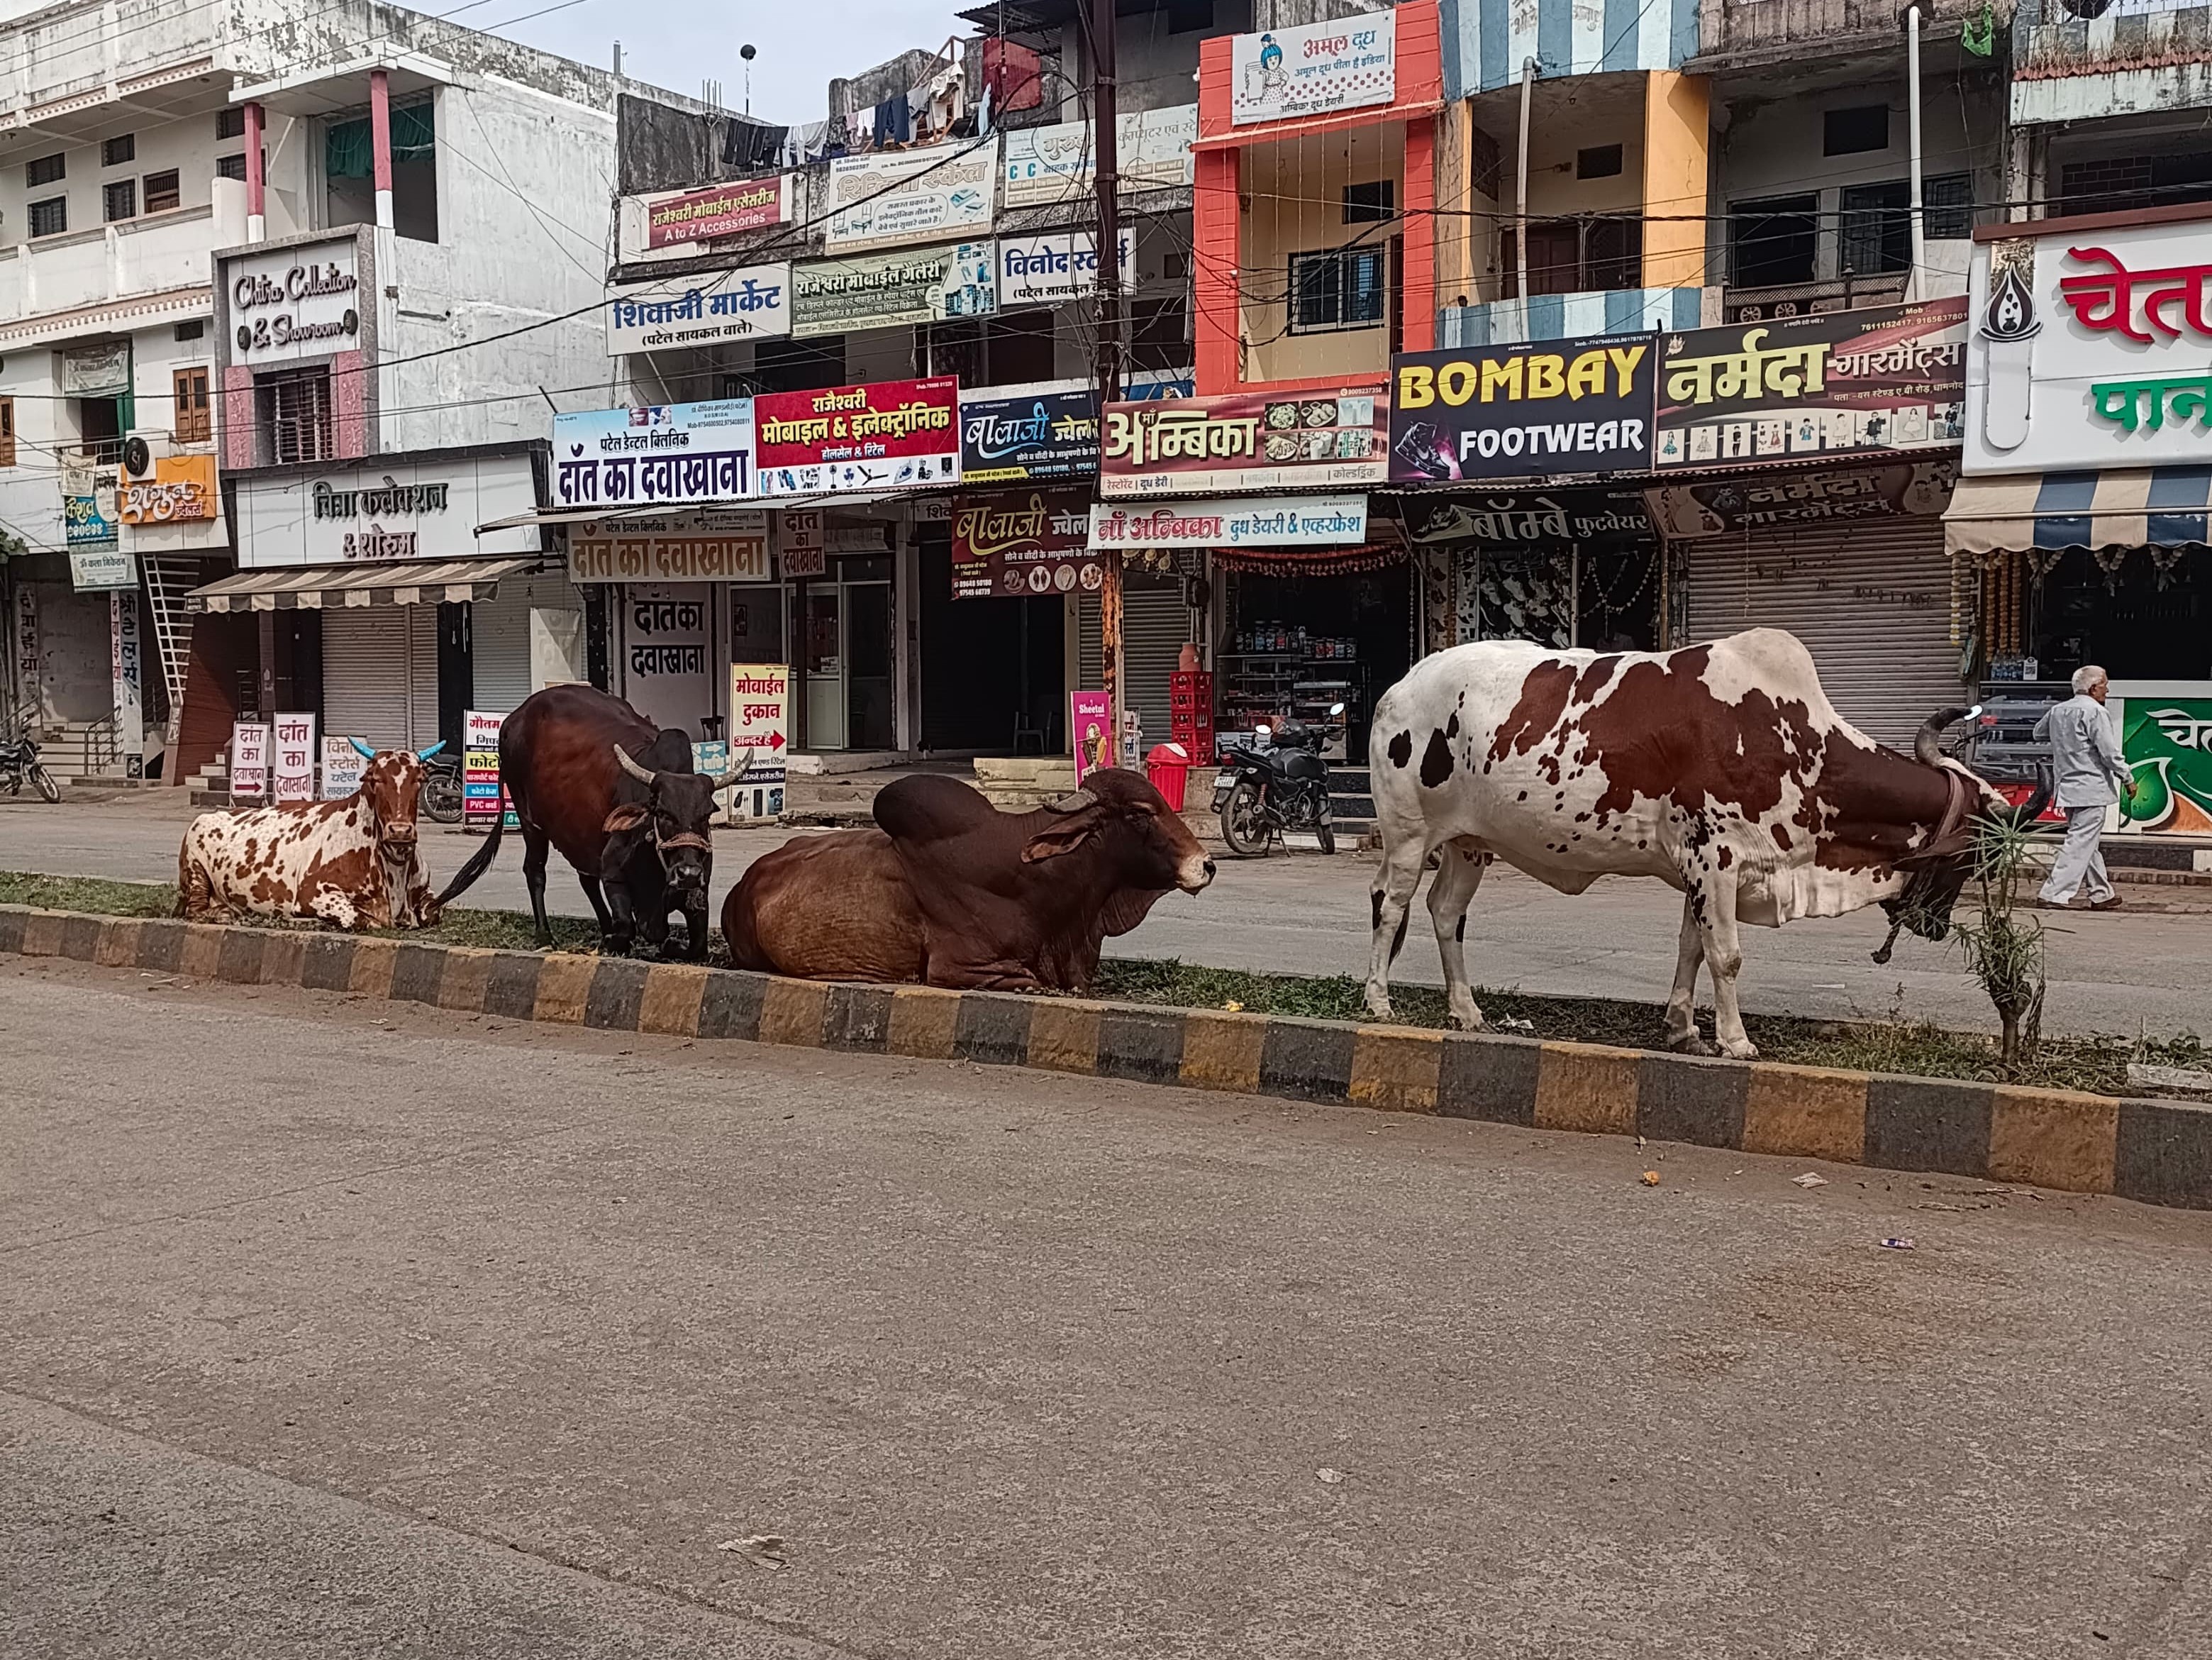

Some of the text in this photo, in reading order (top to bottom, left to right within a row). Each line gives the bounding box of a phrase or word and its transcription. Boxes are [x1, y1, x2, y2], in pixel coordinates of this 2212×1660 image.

[1352, 29, 1377, 50] दूध
[1294, 55, 1385, 78] अमूल दूध पीता है इंडिया
[1311, 101, 1323, 112] दूध
[1325, 94, 1344, 107] डेयरी
[1165, 121, 1179, 136] एवं
[652, 203, 692, 227] राजेश्वरी
[693, 199, 732, 218] मोबाईल
[664, 211, 766, 242] A to Z Accessories
[1005, 245, 1069, 277] विनोद
[233, 262, 357, 309] Chitra Collection
[2060, 246, 2212, 343] चेत
[613, 279, 782, 329] शिवाजी मार्केट
[252, 314, 344, 348] & Showroom
[642, 319, 752, 346] (पटेल सायकल वाले)
[1399, 345, 1649, 409] BOMBAY
[1665, 328, 1963, 404] नर्मदा गारमेंट्स
[1933, 380, 1964, 392] धामनोद
[761, 402, 950, 446] मोबाइल & इलेक्ट्रॉनिक
[965, 402, 1100, 459] बालाजी ज्वेल
[601, 428, 689, 452] पटेल डेन्टल क्लिनिक
[1105, 411, 1260, 465] अम्बिका
[1460, 419, 1645, 463] FOOTWEAR
[821, 443, 886, 460] होलसेल & रिटेल
[1049, 450, 1056, 459] के
[1082, 446, 1089, 456] के
[603, 458, 636, 501] का
[640, 450, 749, 500] दवाखाना
[1140, 476, 1153, 489] दूध
[1155, 475, 1168, 487] डेरी
[312, 475, 448, 519] चित्रा कलेक्शन
[1747, 473, 1881, 504] नर्मदा
[66, 497, 95, 524] केशव
[176, 499, 203, 516] ज्वेलर्स
[1467, 497, 1650, 541] बॉम्बे फुटवेयर
[606, 519, 667, 533] पटेल डेन्टल क्लिनिक
[957, 493, 1090, 555] बालाजी ज्वेल
[1098, 511, 1126, 540] माँ
[1129, 509, 1224, 540] अम्बिका
[1252, 512, 1285, 535] डेयरी
[1288, 512, 1298, 533] &
[343, 533, 357, 558] &
[796, 532, 809, 548] का
[88, 558, 102, 568] कला
[103, 553, 126, 566] निकेतन
[617, 538, 650, 576] का
[655, 536, 765, 578] दवाखाना
[783, 546, 823, 575] दवाखाना
[1005, 550, 1017, 562] सोने
[1039, 550, 1047, 559] के
[1075, 548, 1082, 557] के
[678, 602, 704, 632] का
[631, 644, 705, 677] दवाखाना
[736, 673, 785, 697] मोबाईल
[742, 704, 781, 726] दुकान
[1079, 703, 1105, 714] Sheetal
[240, 726, 264, 743] दांत
[279, 719, 309, 743] दांत
[469, 716, 500, 729] गौतम
[734, 735, 762, 747] अन्दर
[241, 748, 260, 762] का
[283, 751, 306, 768] का
[329, 756, 360, 770] स्टोर्स
[469, 755, 501, 768] फोटो
[771, 756, 785, 765] रिटेल
[233, 767, 264, 781] दवाखाना
[276, 775, 311, 795] दवाखाना
[330, 771, 357, 782] पटेल
